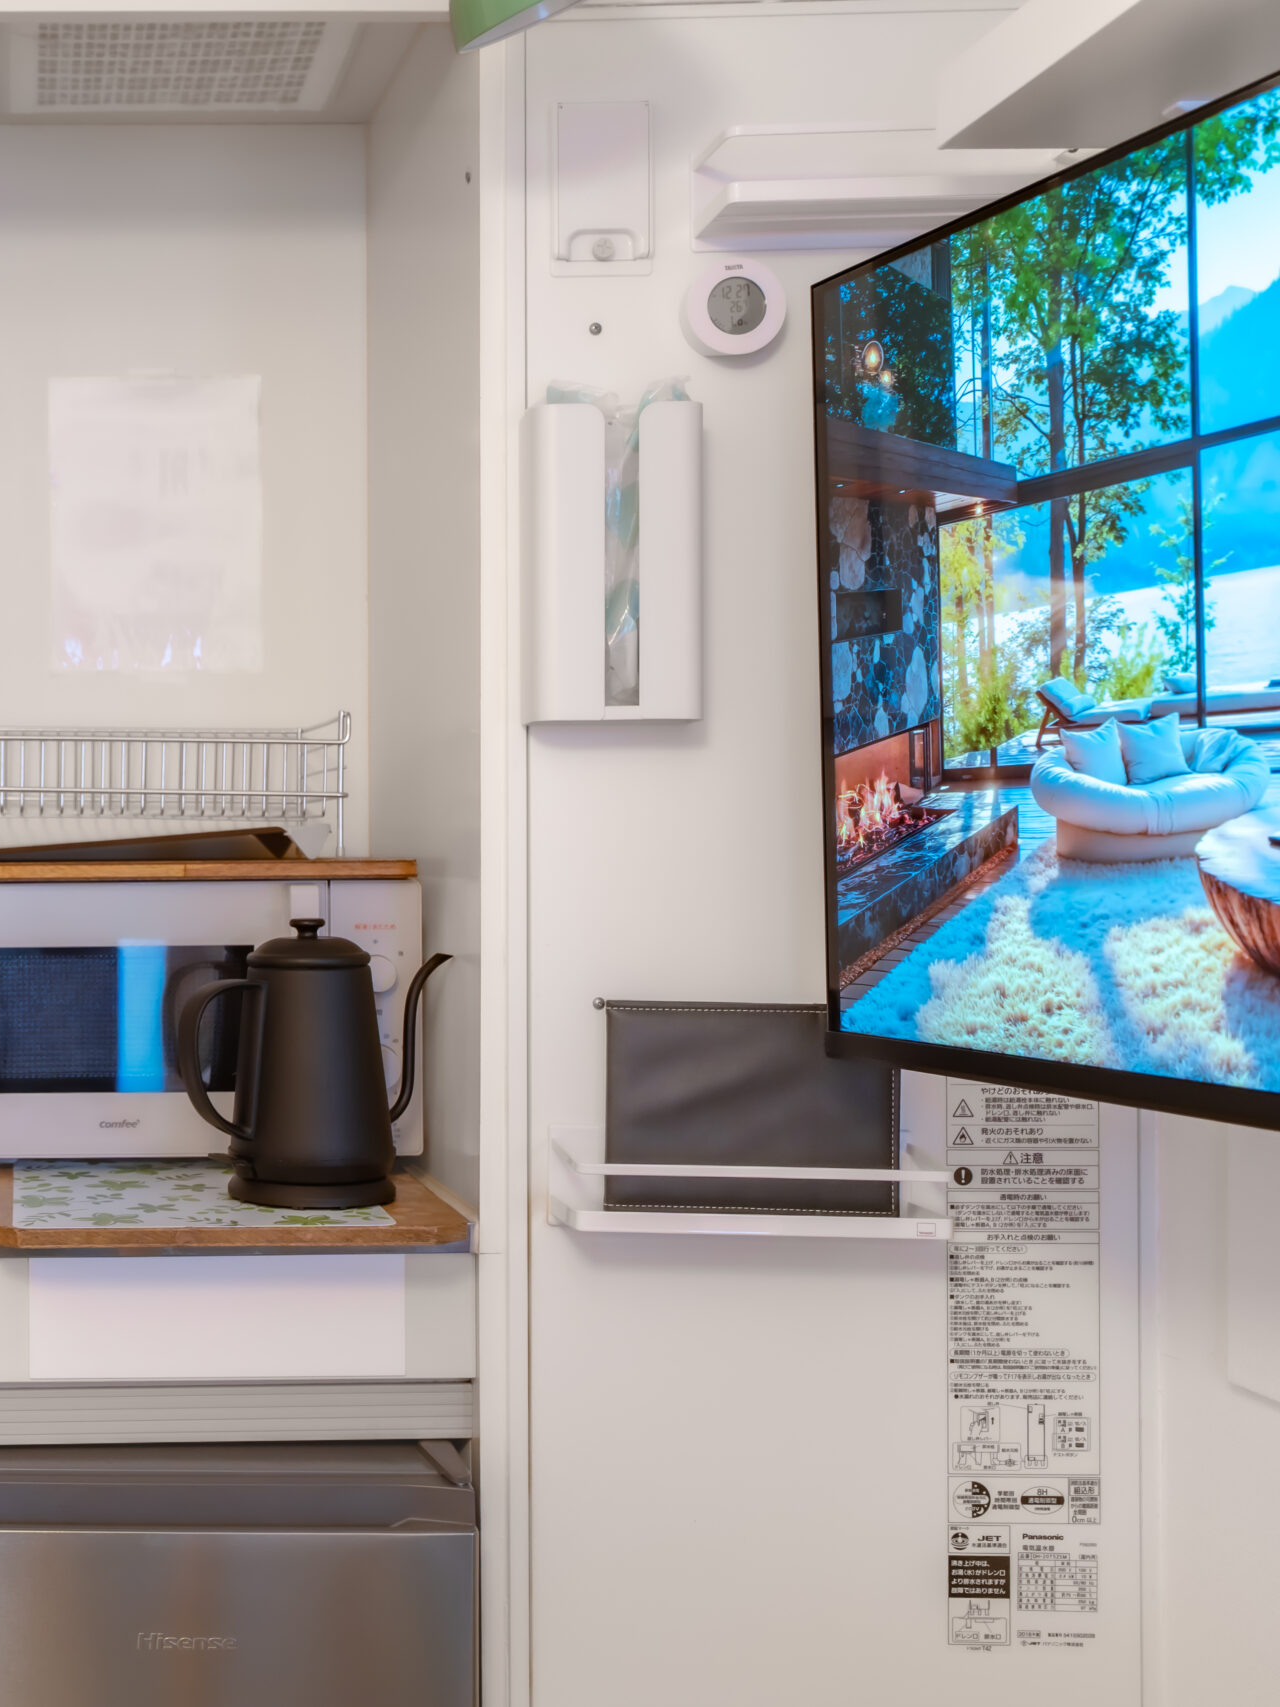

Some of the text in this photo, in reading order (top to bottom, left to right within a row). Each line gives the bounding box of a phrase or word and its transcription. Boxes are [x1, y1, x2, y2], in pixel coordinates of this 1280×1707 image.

[981, 1128, 1044, 1136] 発火のおそれあり
[1020, 1153, 1044, 1164] 注意
[981, 1177, 1085, 1185] 設置されていることを確認する
[1022, 1533, 1064, 1541] Panasonic
[137, 1632, 237, 1649] Hisense
